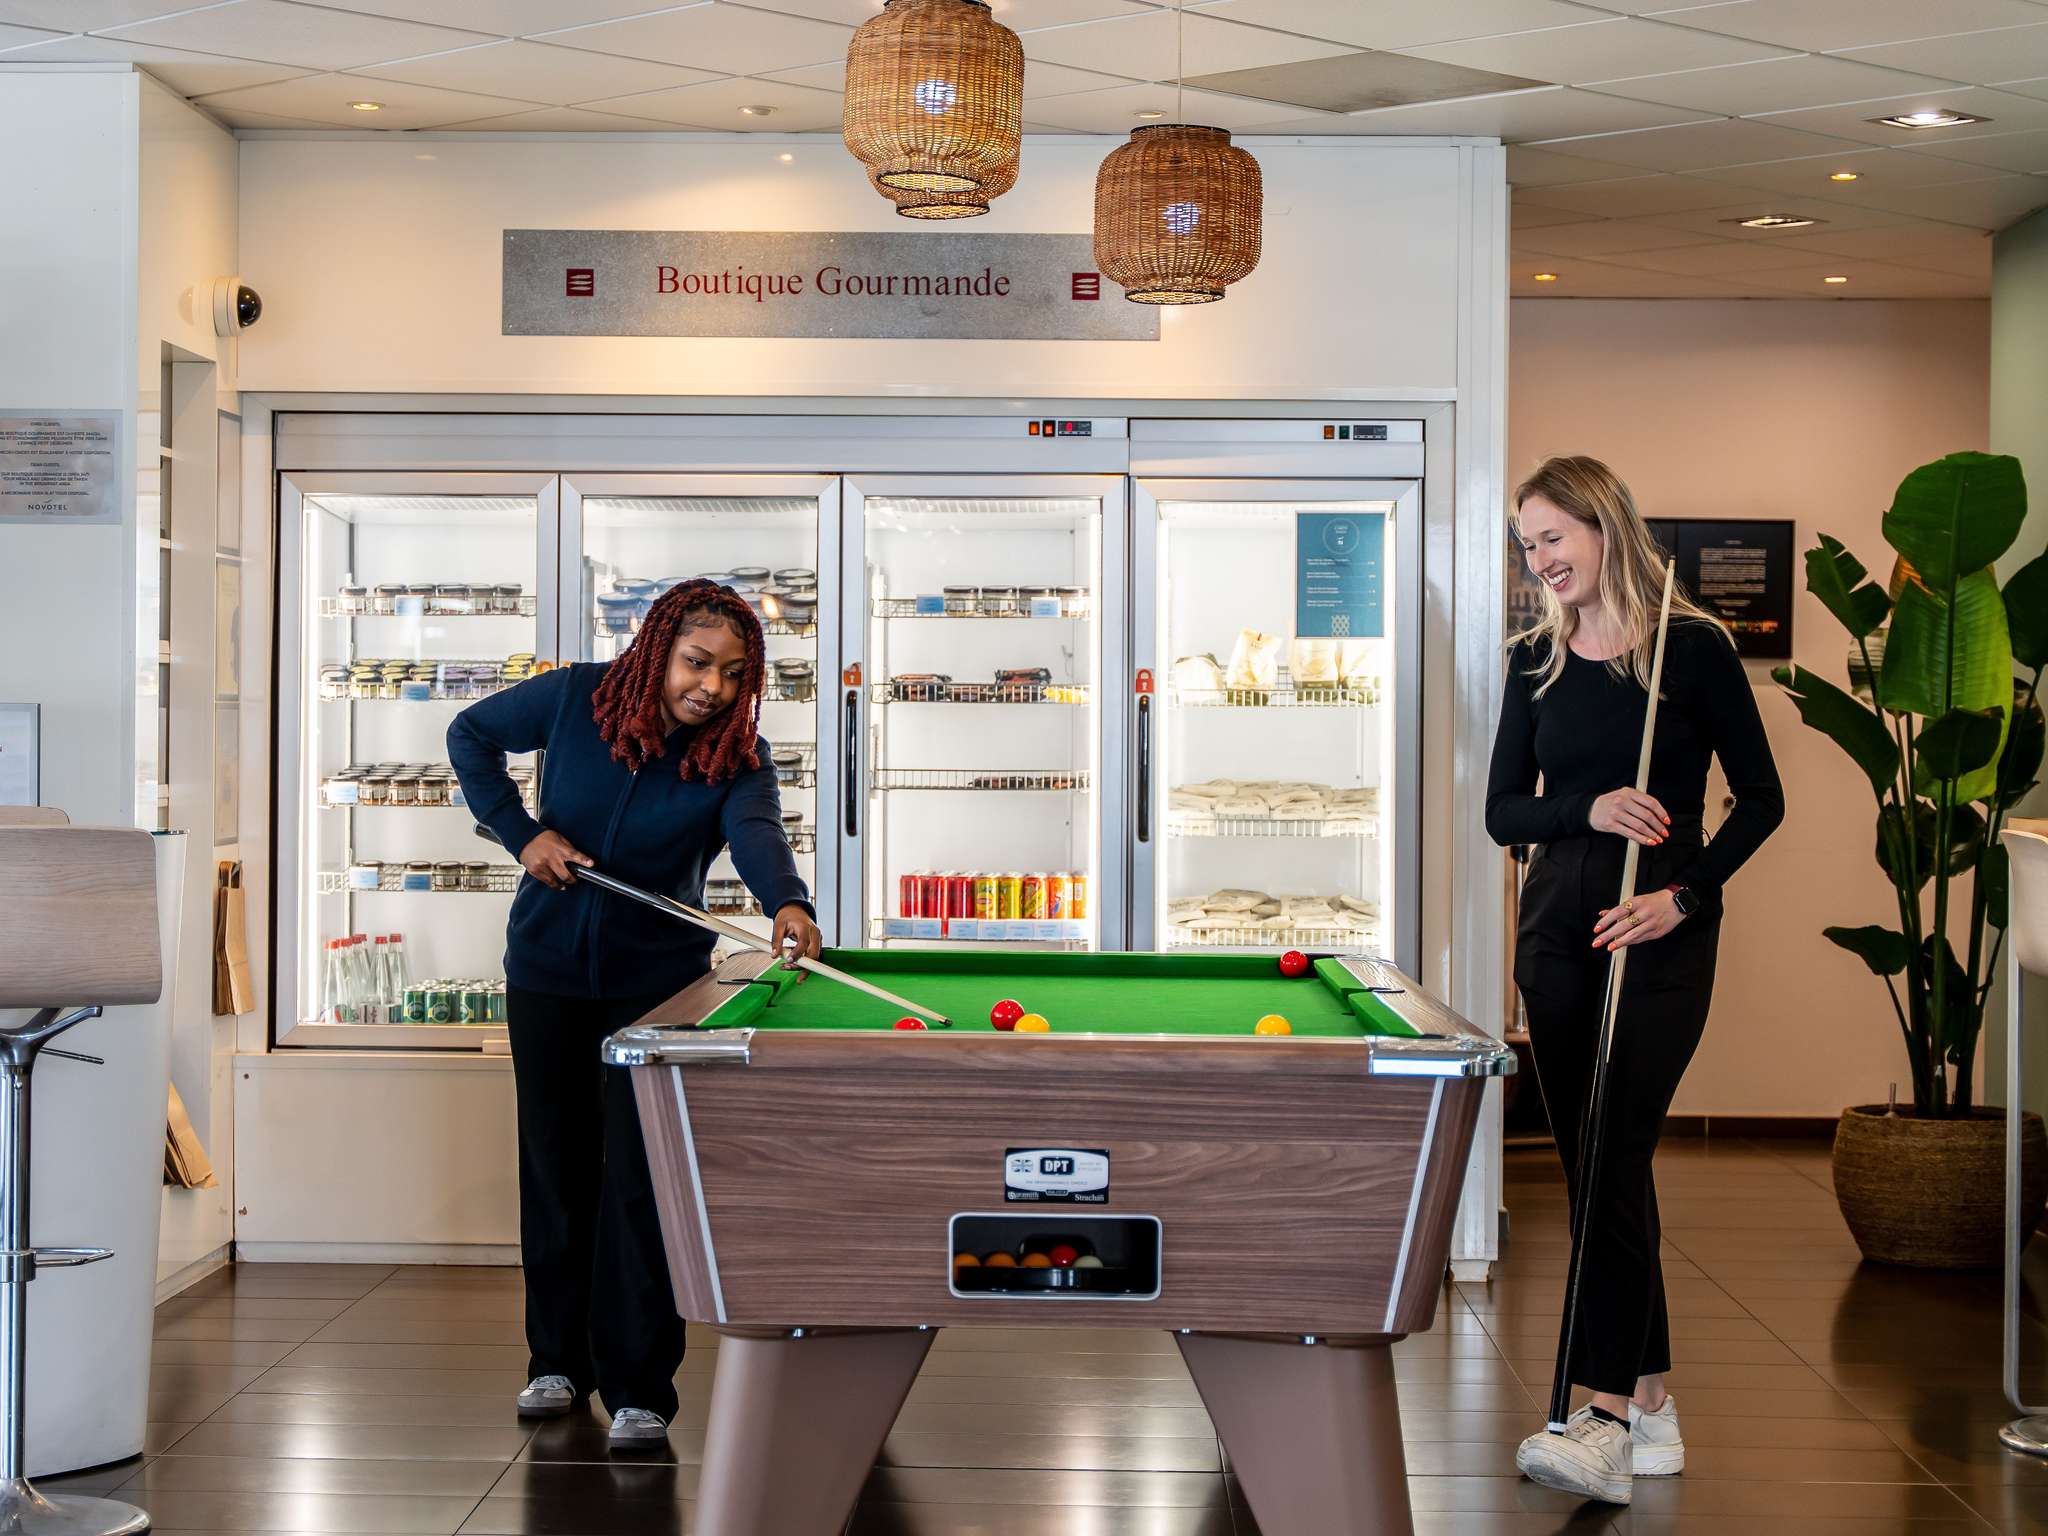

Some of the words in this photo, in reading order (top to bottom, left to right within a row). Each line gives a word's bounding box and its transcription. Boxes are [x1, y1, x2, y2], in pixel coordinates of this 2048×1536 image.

[656, 265, 804, 302] Boutique
[815, 266, 1012, 296] Gourmande
[1044, 1160, 1069, 1172] DPT
